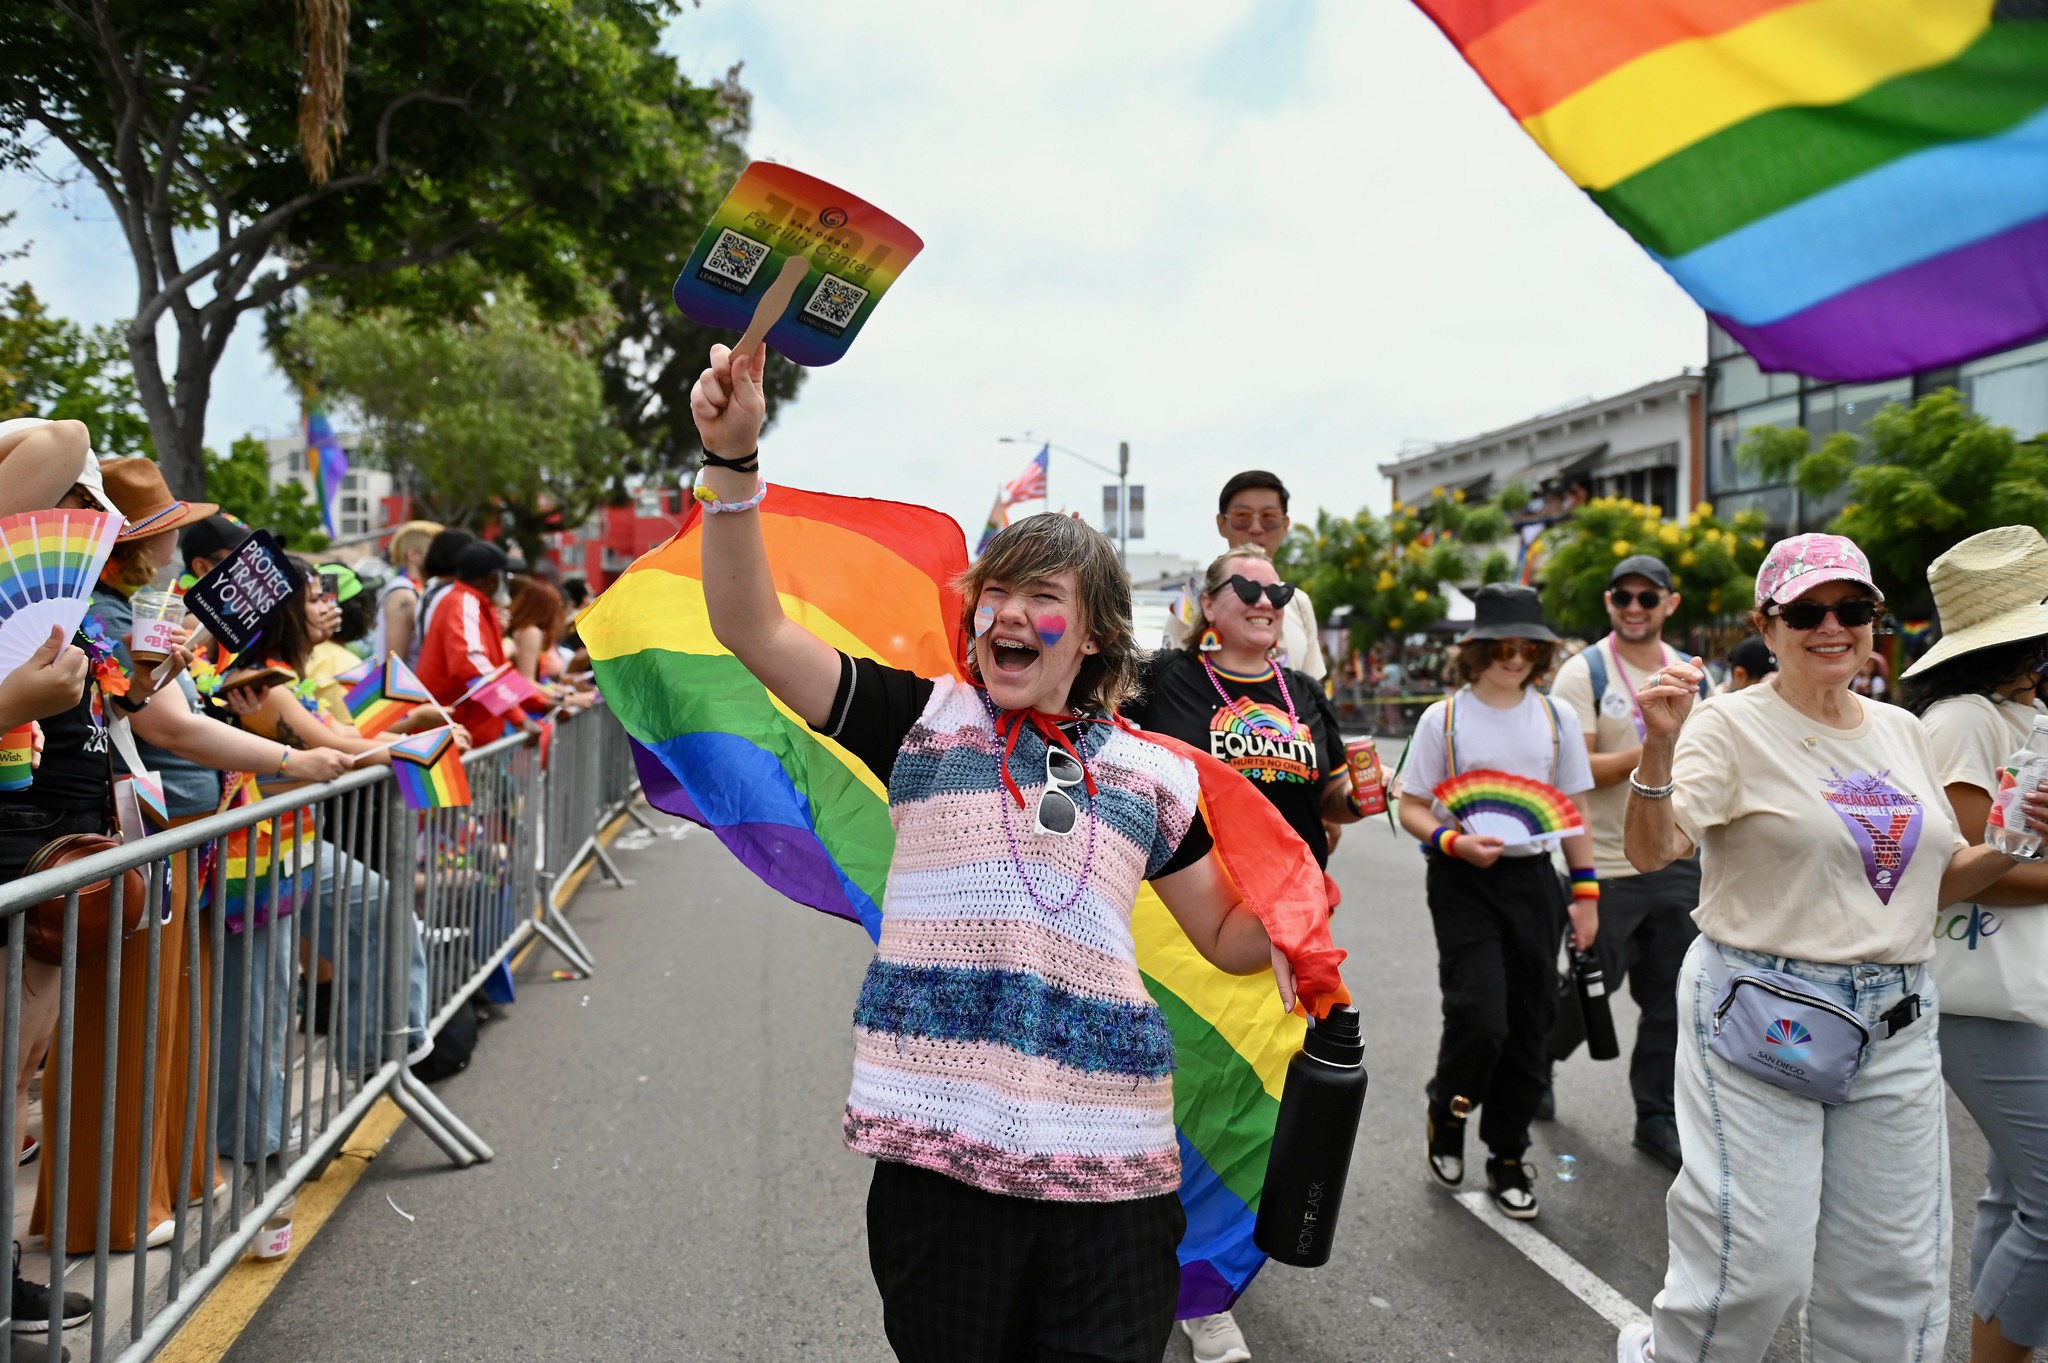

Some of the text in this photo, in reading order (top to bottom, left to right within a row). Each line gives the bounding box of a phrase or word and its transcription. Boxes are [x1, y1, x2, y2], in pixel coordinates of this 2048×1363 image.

[744, 211, 875, 276] Fertility Center
[790, 219, 849, 249] SAN DIEGO
[699, 271, 743, 294] LEARN MORE
[242, 539, 293, 601] PROTECT
[228, 557, 275, 614] TRANS
[211, 572, 260, 630] YOUTH
[1209, 730, 1318, 769] EQUALITY
[1233, 758, 1266, 767] HURTS
[1267, 759, 1281, 768] NO
[1820, 790, 1921, 807] UNBREAKABLE PRIDE
[1888, 805, 1919, 816] POWER
[1747, 1053, 1810, 1083] Community College District
[1758, 1051, 1805, 1076] SAN DIEGO
